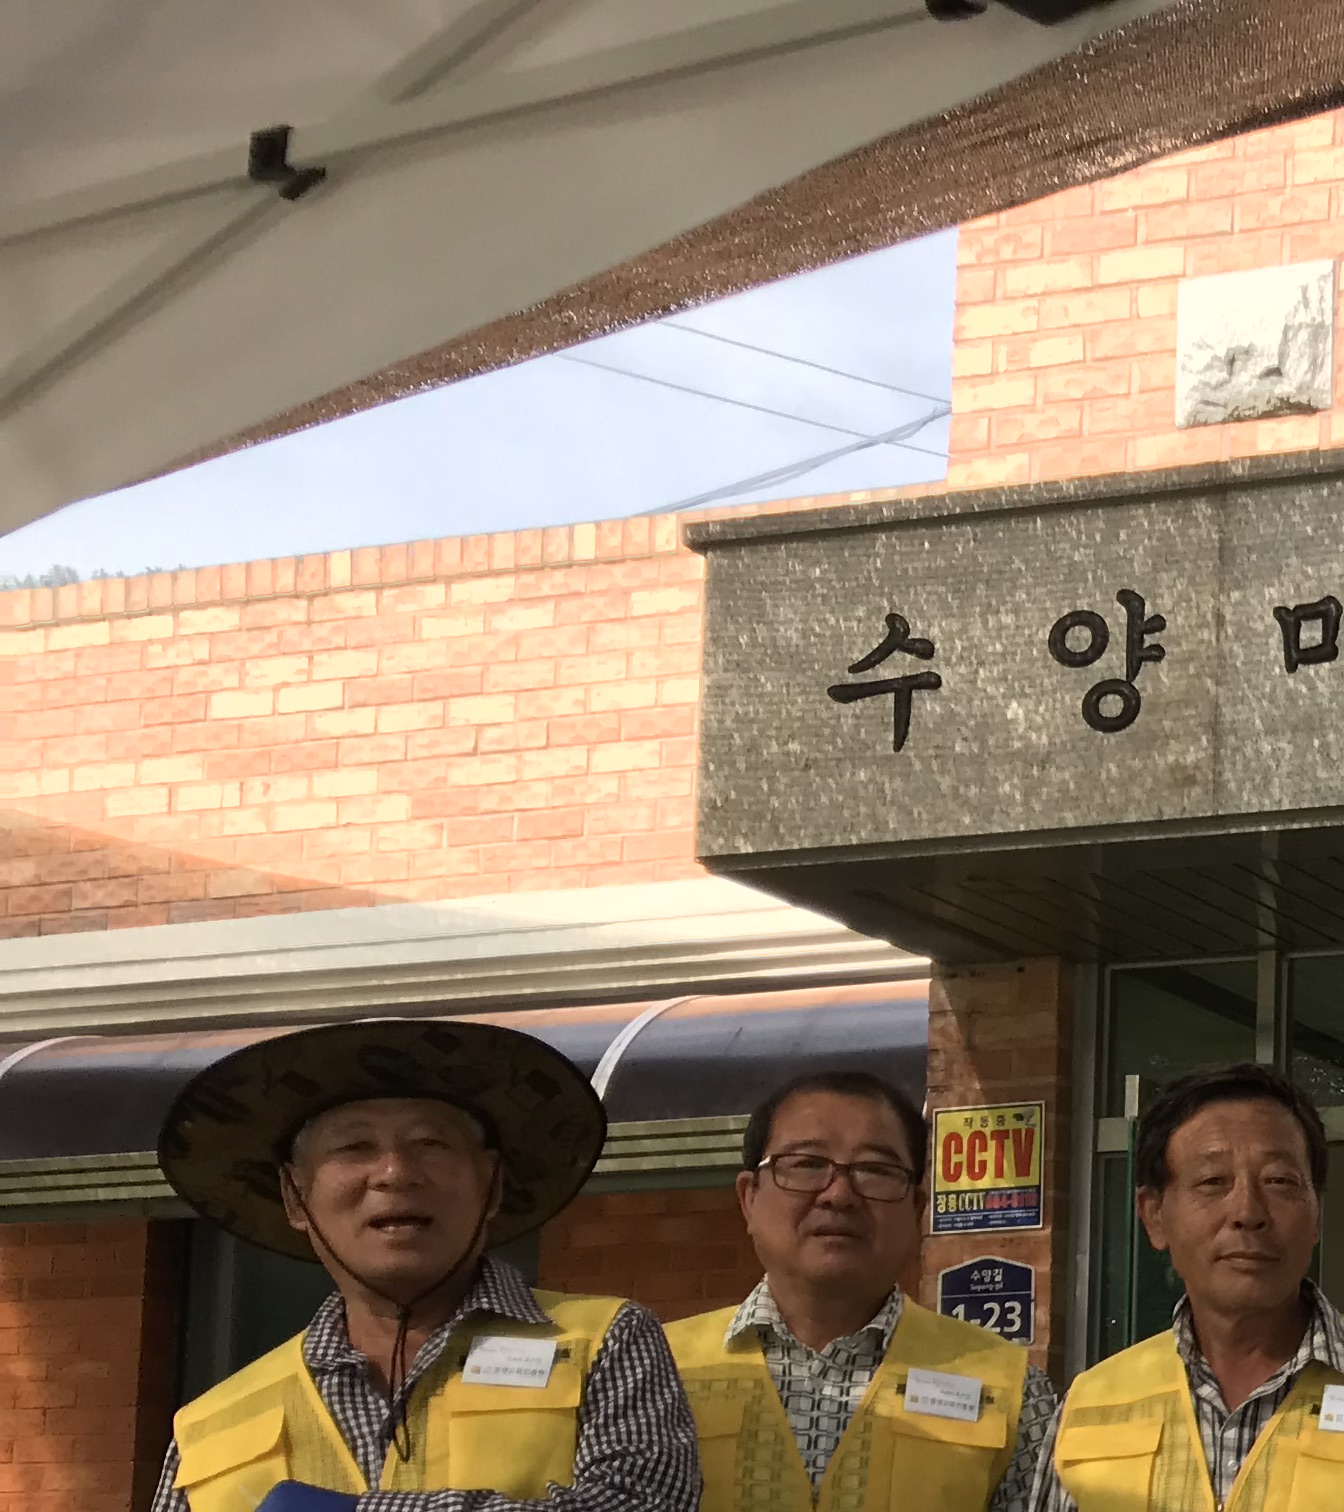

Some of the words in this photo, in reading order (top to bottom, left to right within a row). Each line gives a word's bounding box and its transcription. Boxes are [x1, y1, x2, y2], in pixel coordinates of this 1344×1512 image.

[942, 1128, 1034, 1183] CCTV
[970, 1268, 1004, 1282] 수양길
[951, 1301, 1022, 1333] 1-23
